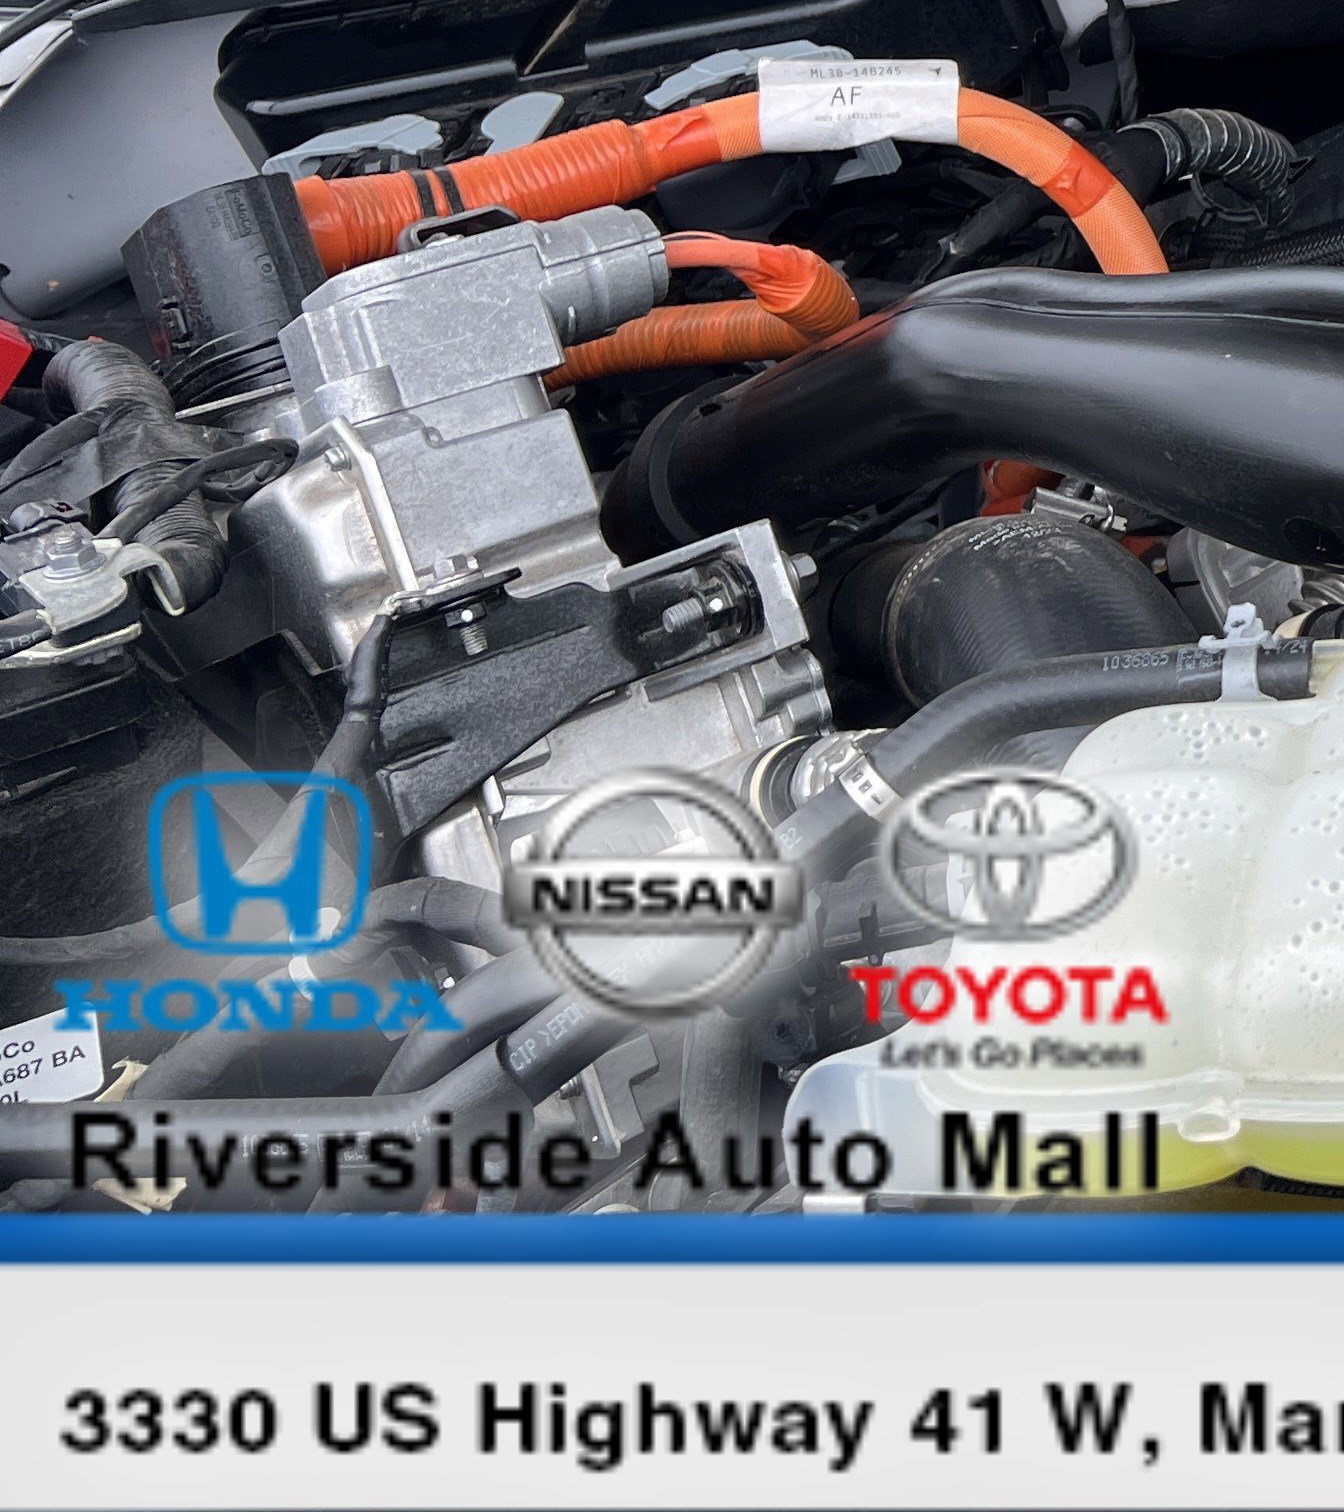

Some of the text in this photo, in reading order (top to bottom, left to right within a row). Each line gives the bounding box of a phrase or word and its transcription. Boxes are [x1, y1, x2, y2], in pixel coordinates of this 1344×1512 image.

[830, 85, 863, 106] AF
[0, 1040, 35, 1060] Co
[0, 1044, 86, 1087] 687 BA
